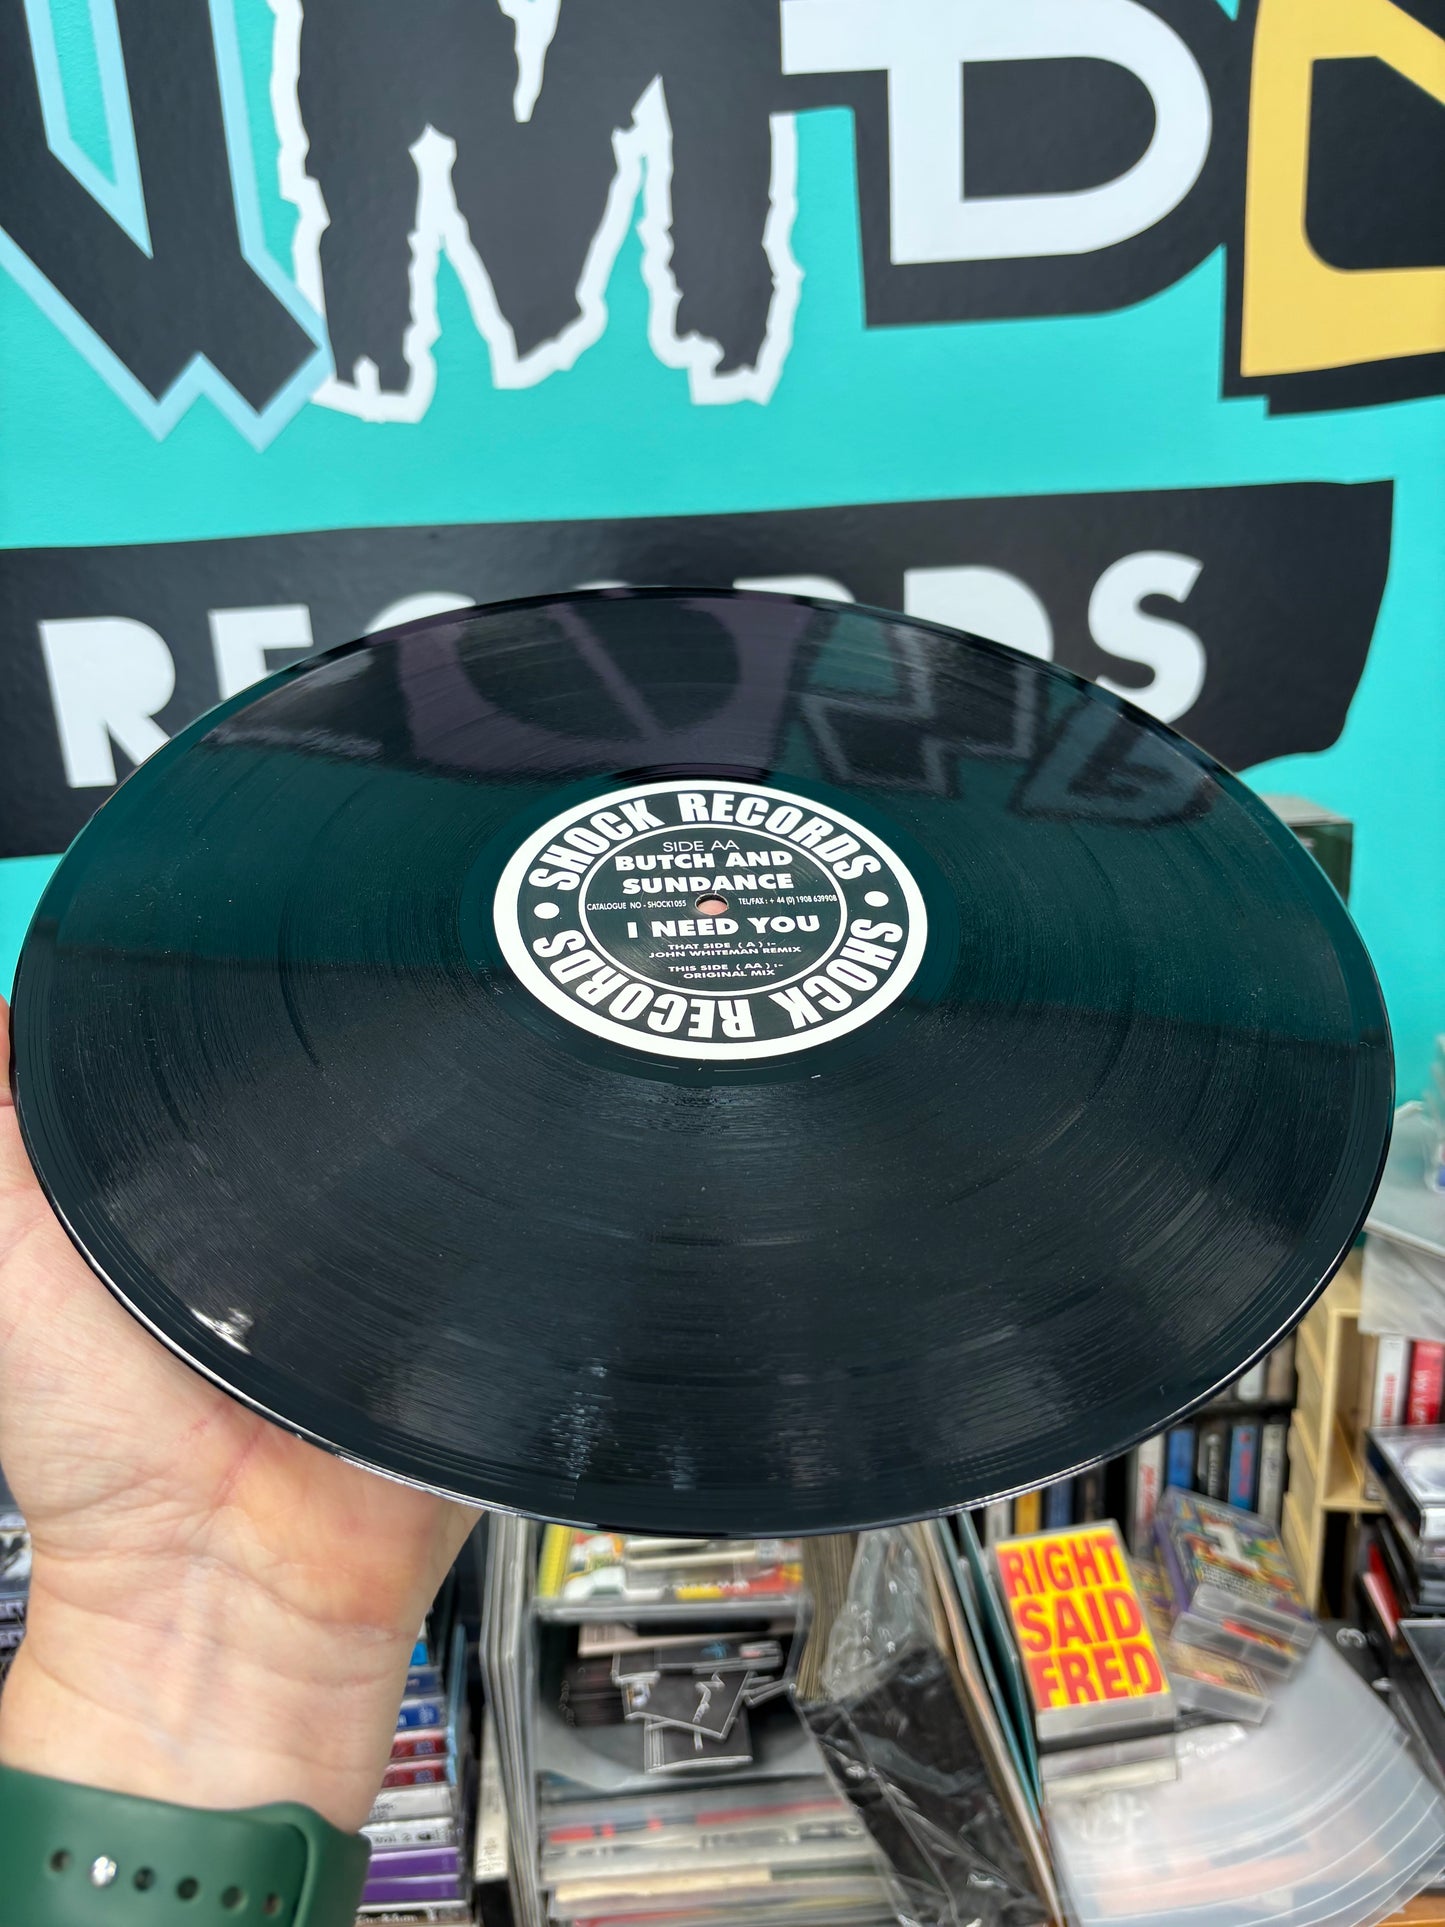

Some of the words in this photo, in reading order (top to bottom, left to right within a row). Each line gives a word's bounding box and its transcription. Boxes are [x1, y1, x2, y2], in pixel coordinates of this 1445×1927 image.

[528, 799, 665, 892] SHOCK
[677, 792, 881, 881] RECORDS
[662, 840, 705, 853] SIDE
[710, 839, 740, 851] AA
[615, 853, 716, 872] BUTCH
[725, 850, 793, 868] AND
[621, 873, 795, 895] SUNDANCE
[586, 902, 627, 911] CATALOGUE
[629, 901, 641, 910] NO
[647, 900, 687, 909] SHOCK1055
[627, 922, 639, 939] I
[651, 917, 740, 938] NEED
[747, 914, 821, 934] YOU
[649, 950, 686, 959] JOHN
[689, 948, 759, 957] WHITEMAN
[762, 946, 802, 954] REMIX
[668, 943, 700, 951] THAT
[683, 971, 748, 979] ORIGINAL
[751, 969, 775, 977] MIX
[700, 963, 729, 971] SIDE
[768, 919, 903, 1030] SHOCK
[533, 929, 757, 1040] RECORDS
[996, 1533, 1124, 1598] RIGHT
[1013, 1588, 1143, 1653] SAID
[1029, 1641, 1165, 1711] FRED
